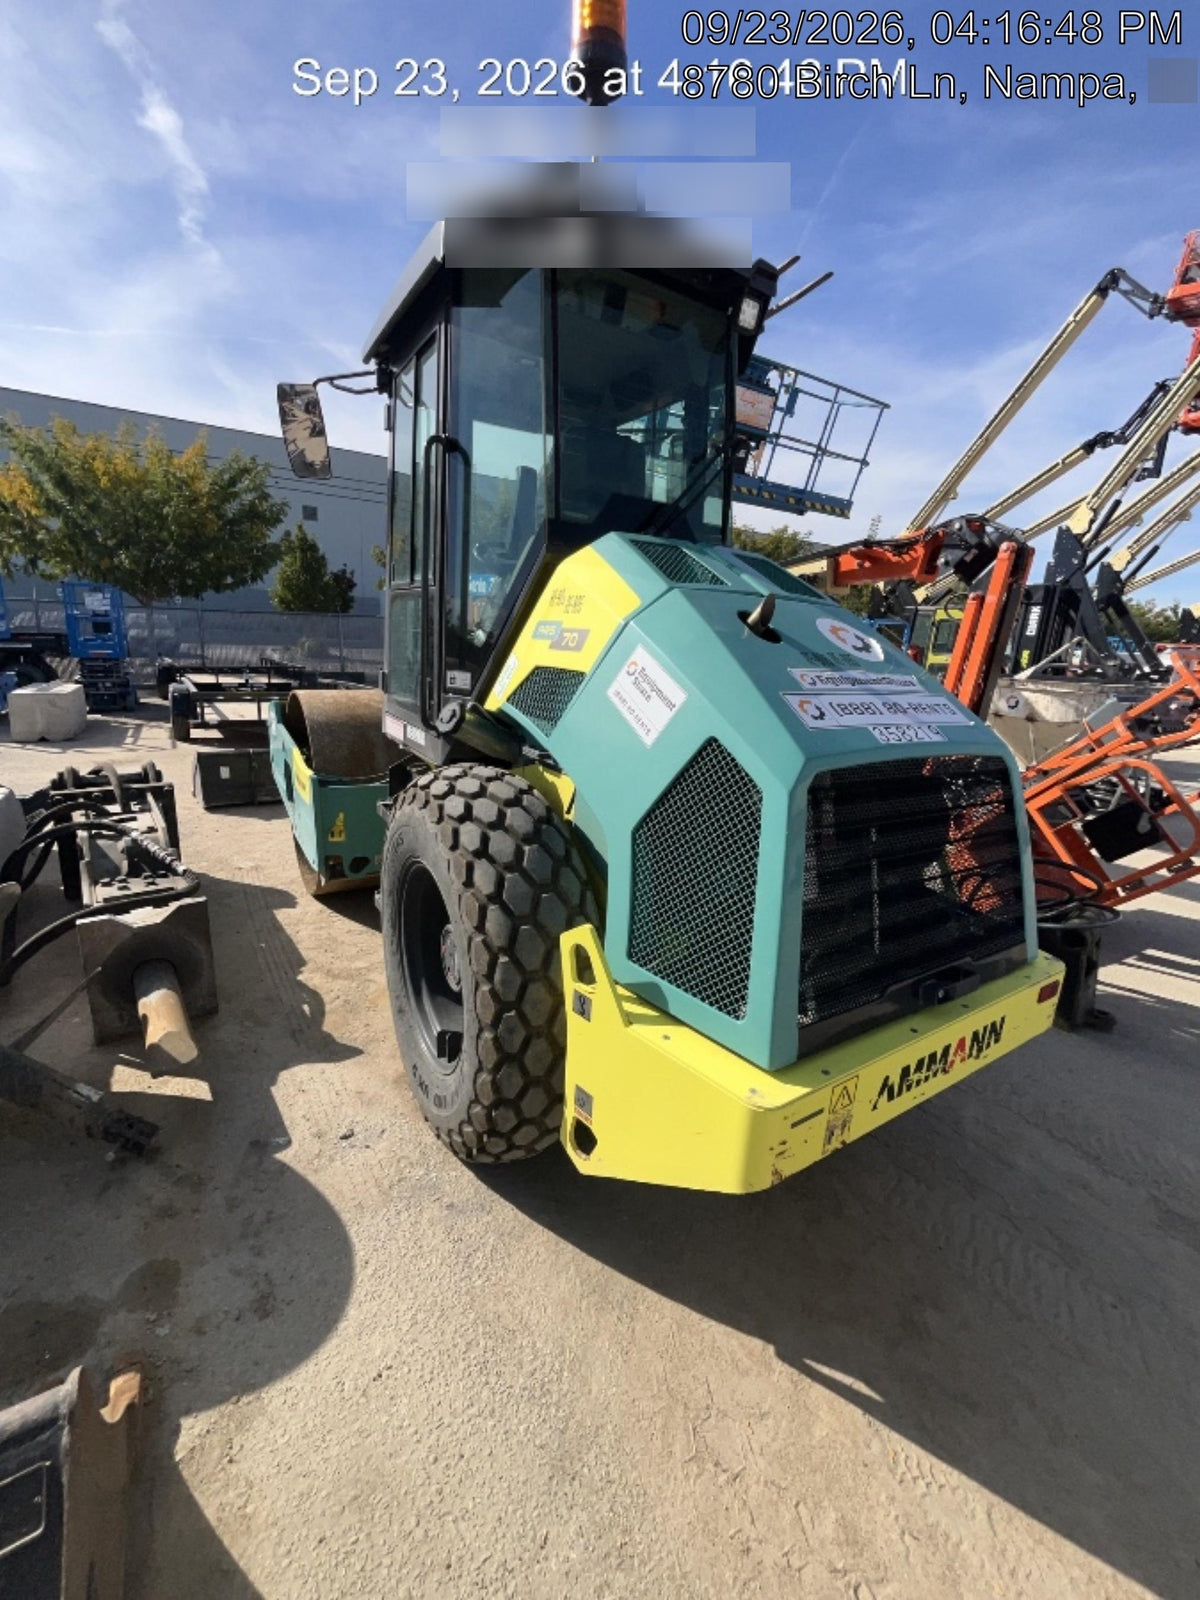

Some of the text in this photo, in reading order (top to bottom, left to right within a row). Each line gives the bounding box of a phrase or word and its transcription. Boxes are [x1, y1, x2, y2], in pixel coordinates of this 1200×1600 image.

[561, 632, 578, 647] 70
[638, 666, 676, 711] Equipment
[829, 702, 884, 717] (888)
[871, 1015, 1005, 1111] AMMANN
